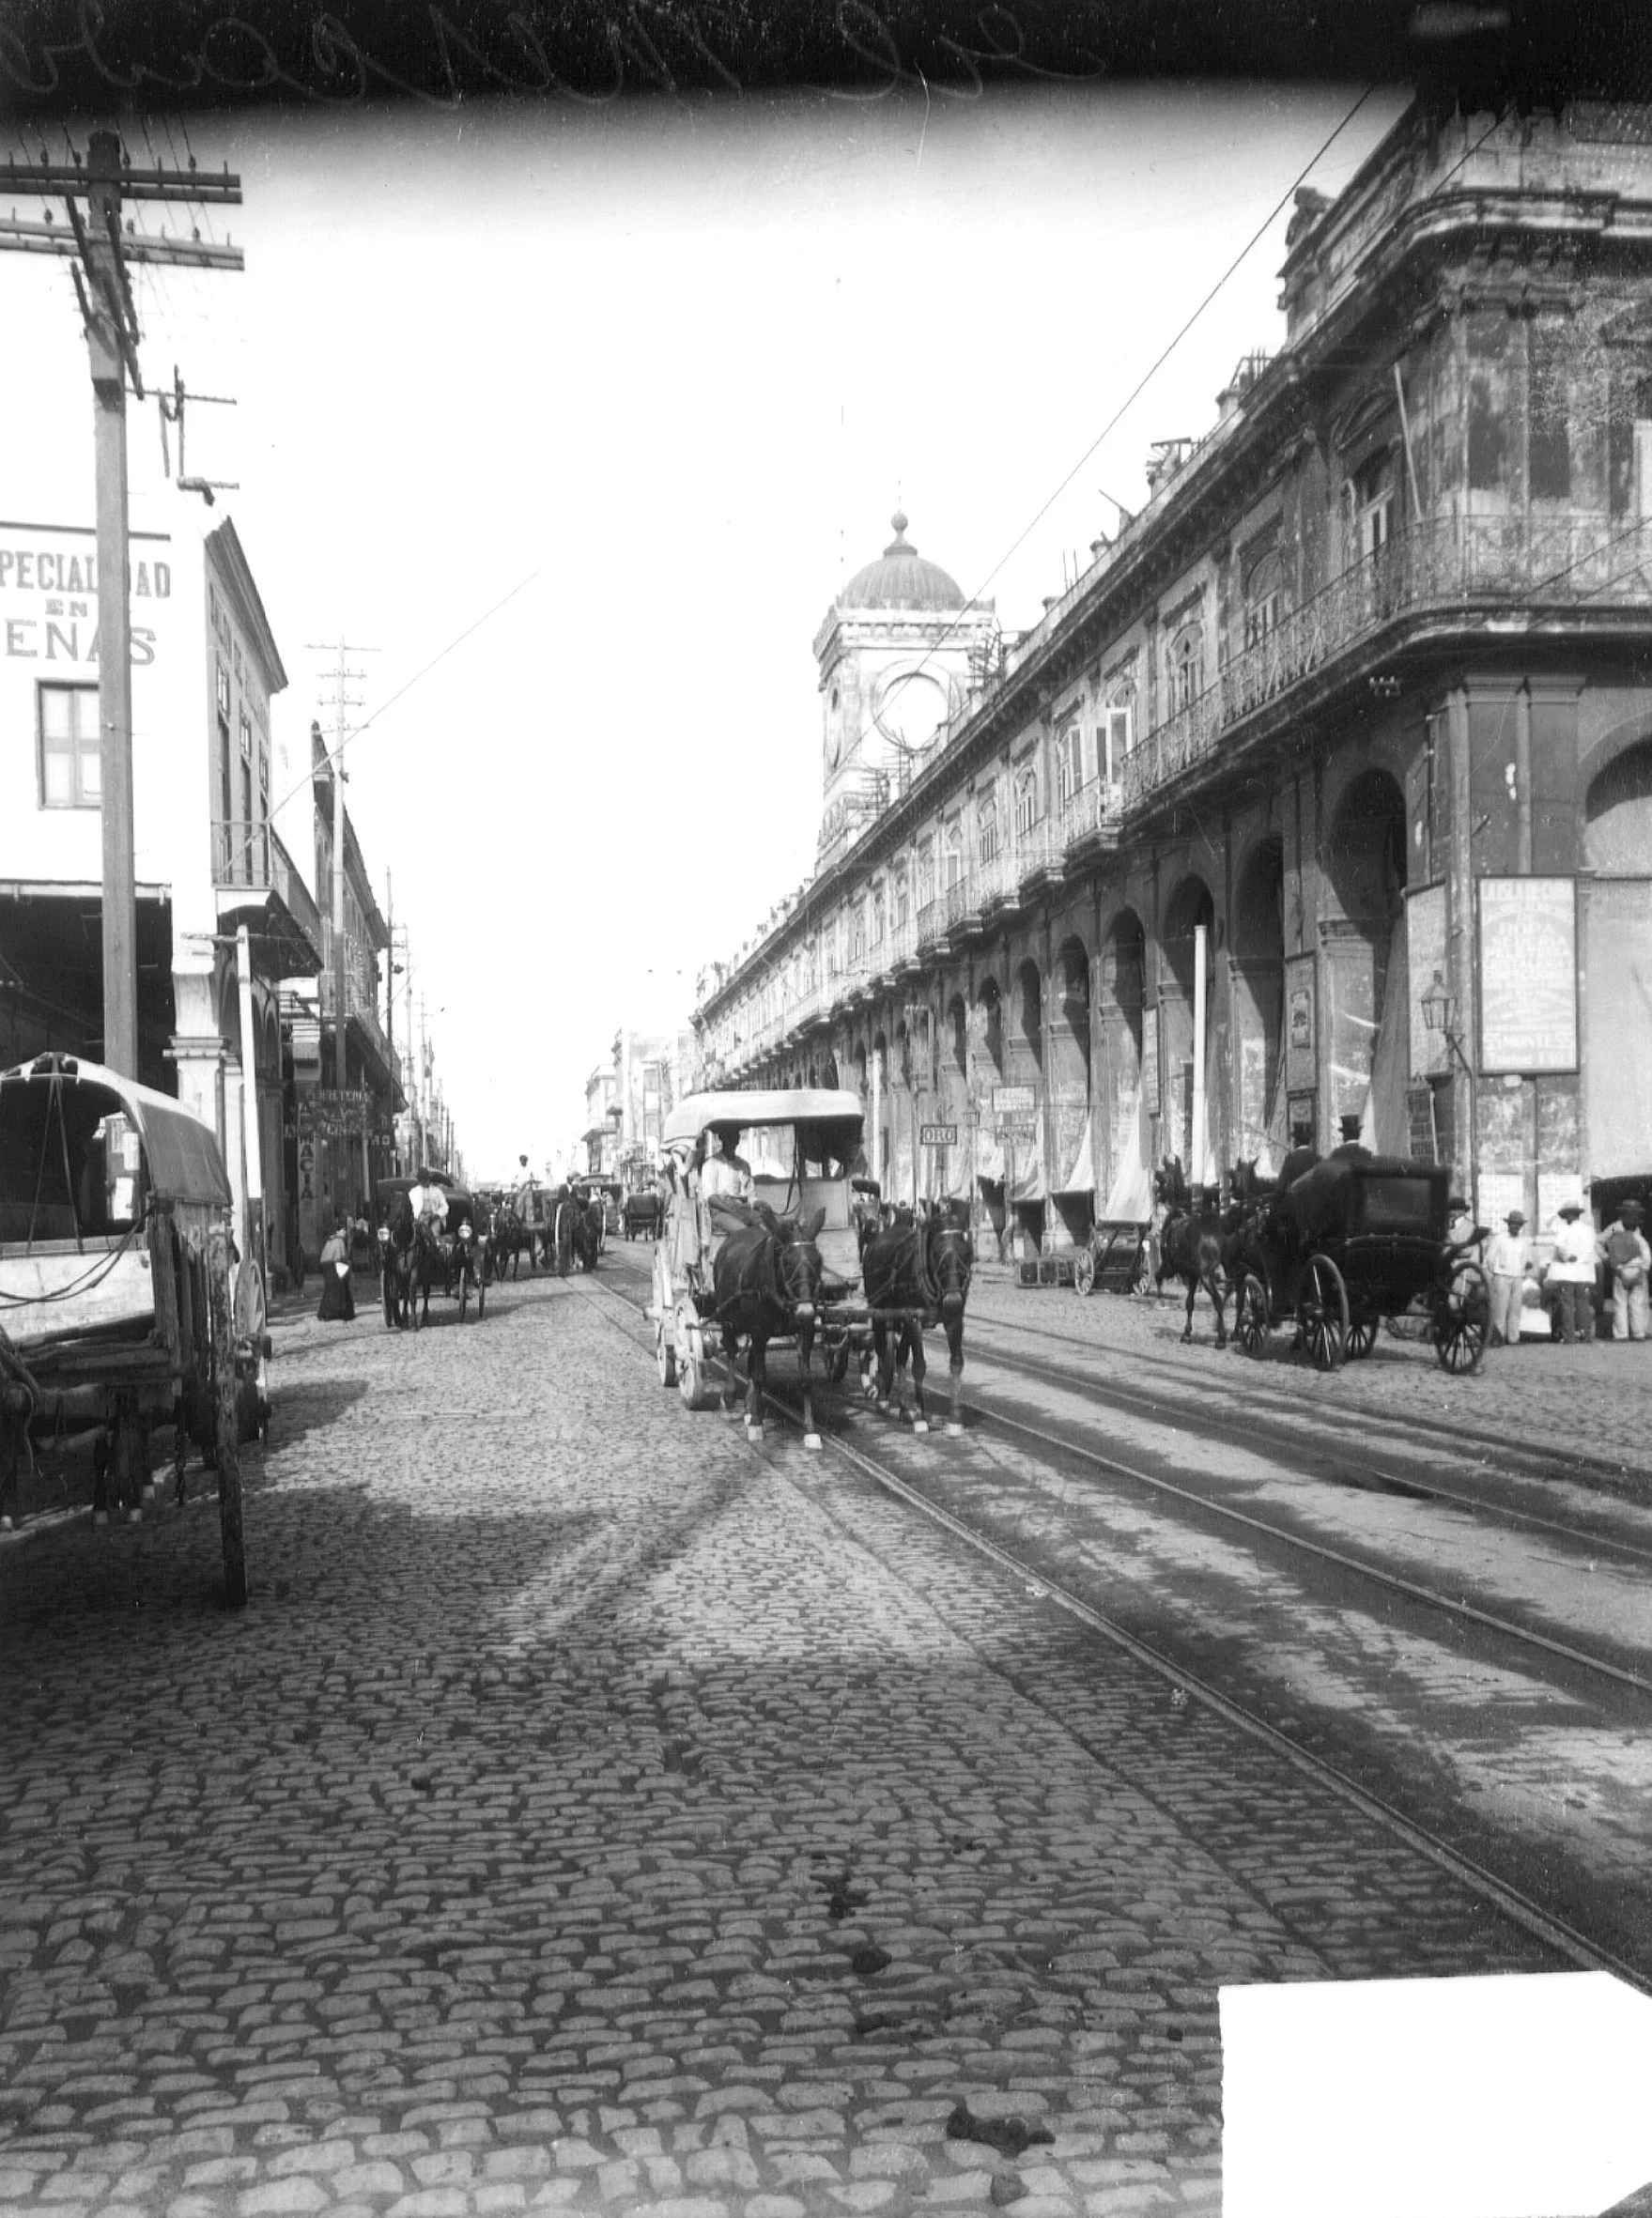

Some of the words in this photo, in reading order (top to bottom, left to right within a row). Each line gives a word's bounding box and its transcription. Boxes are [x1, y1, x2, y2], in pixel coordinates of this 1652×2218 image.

[0, 549, 171, 598] PECIALAD
[45, 597, 88, 618] EN
[924, 1129, 954, 1141] ORO
